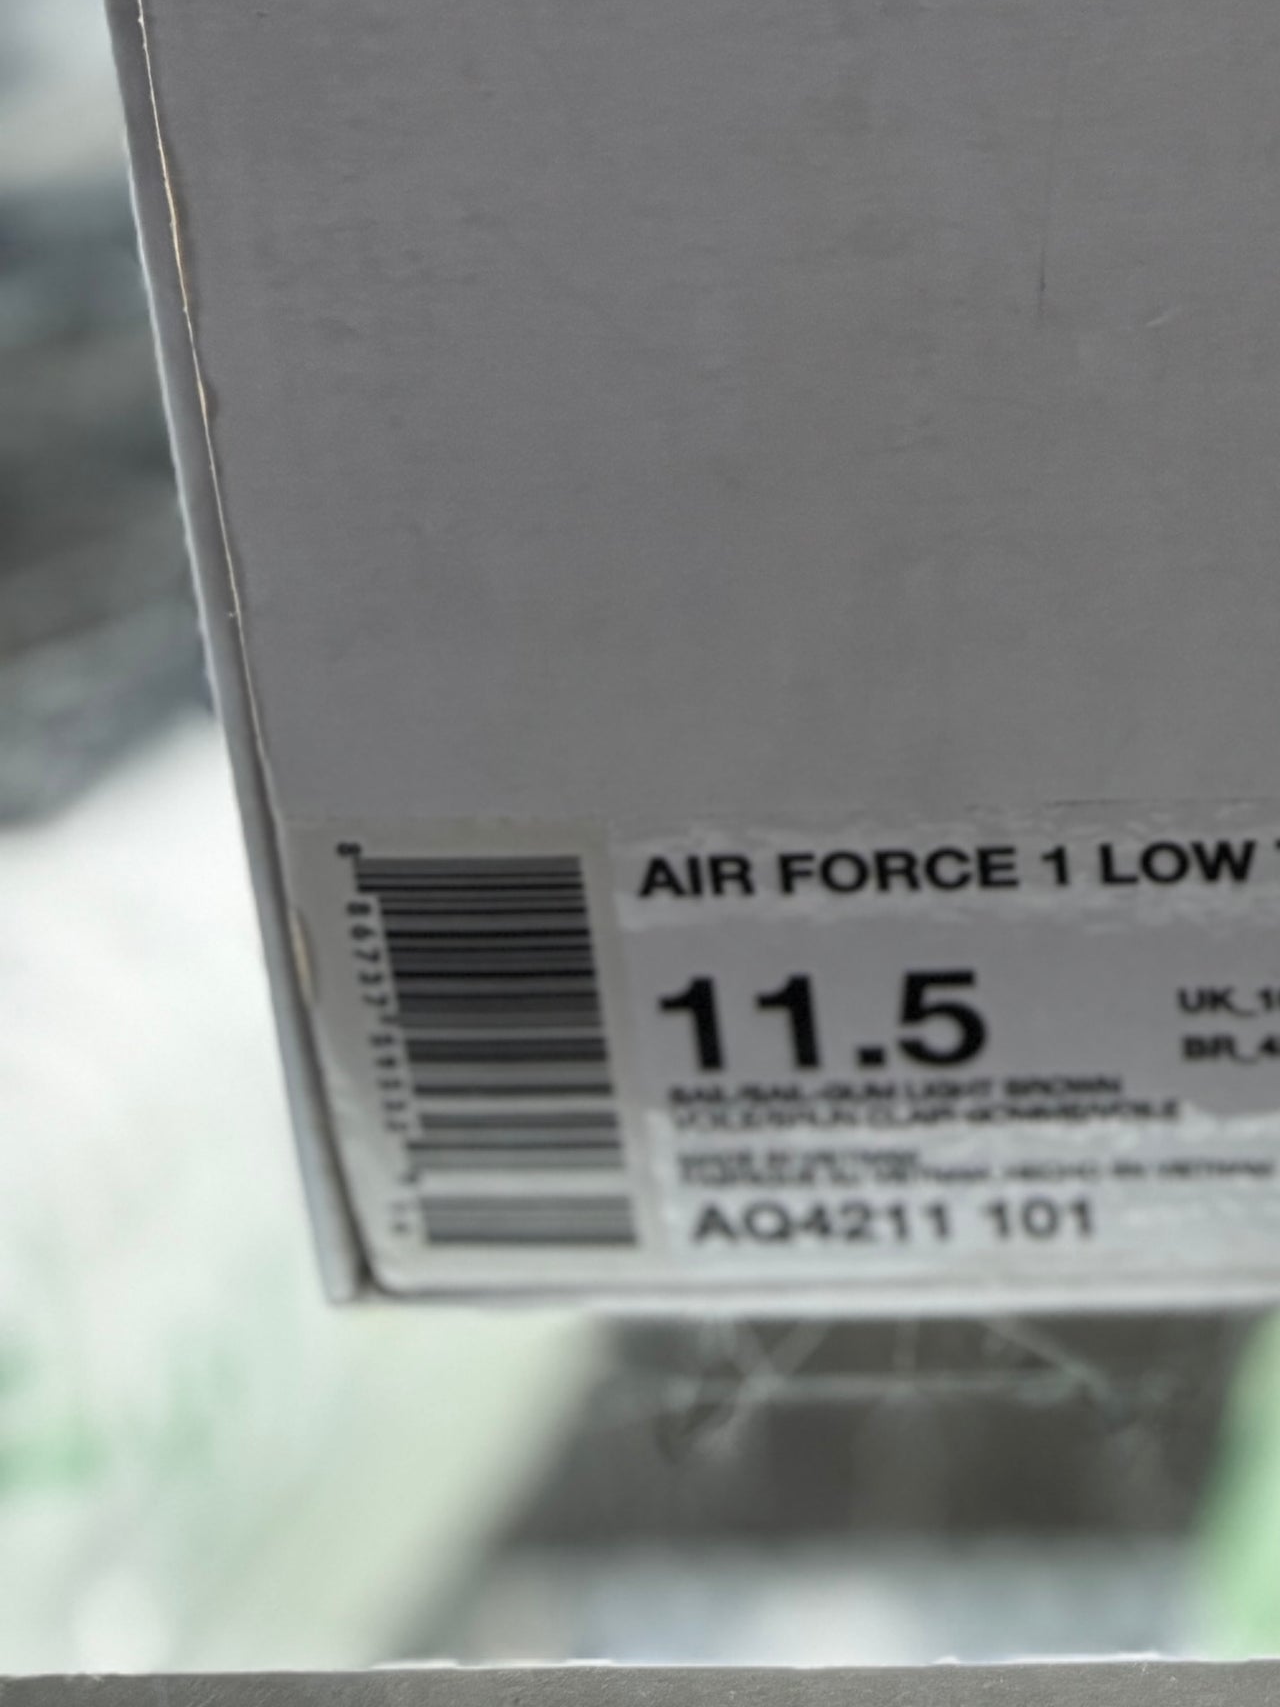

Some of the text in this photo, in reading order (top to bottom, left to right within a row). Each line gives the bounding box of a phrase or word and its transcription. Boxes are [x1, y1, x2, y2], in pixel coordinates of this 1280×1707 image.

[638, 854, 755, 898] AIR
[777, 846, 1021, 895] FORCE
[1040, 845, 1070, 887] 1
[1098, 840, 1256, 886] LOW
[658, 969, 987, 1072] 11.5
[1004, 1075, 1124, 1099] BROWN
[692, 1197, 1093, 1245] AQ4211 101
